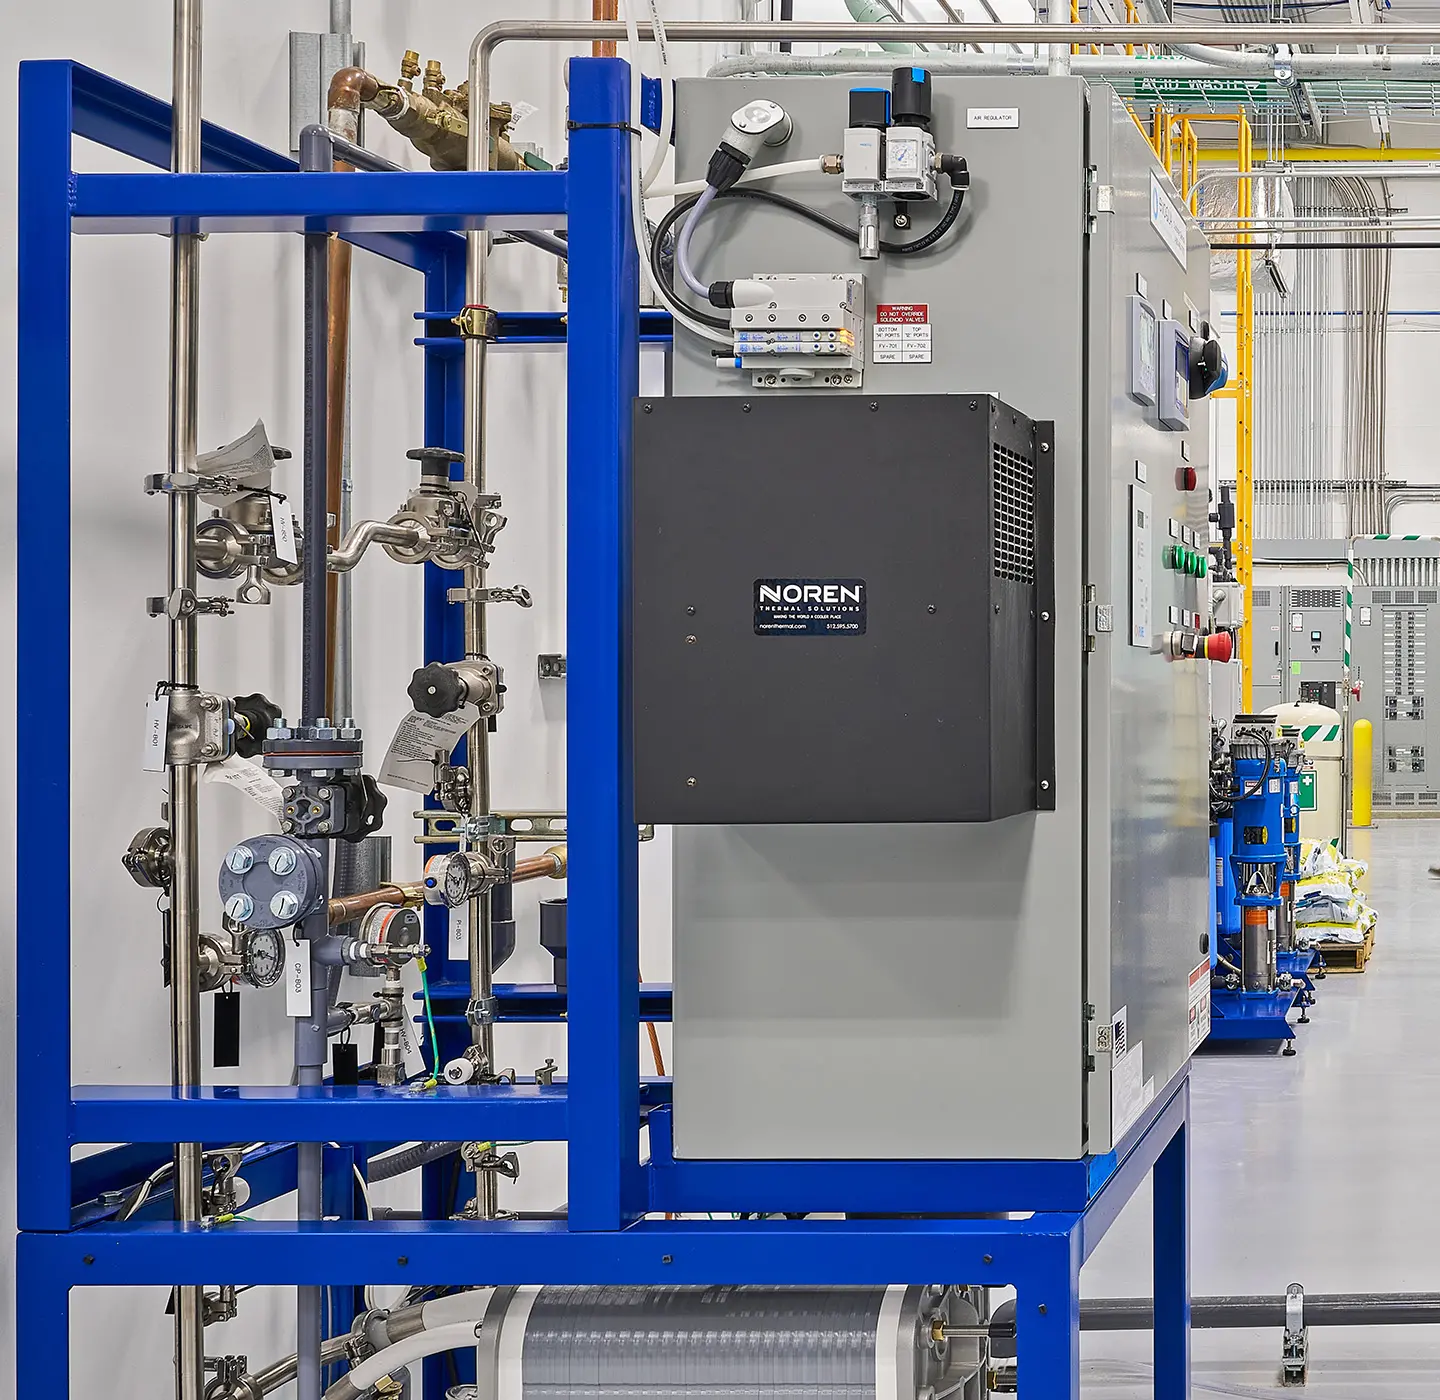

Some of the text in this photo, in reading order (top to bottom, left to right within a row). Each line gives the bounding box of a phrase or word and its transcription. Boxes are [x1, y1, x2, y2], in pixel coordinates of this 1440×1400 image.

[1141, 77, 1179, 91] ACID
[759, 584, 860, 603] NOREN
[152, 719, 160, 748] HV-801
[294, 962, 302, 994] CP-803
[399, 1027, 412, 1056] HV-804
[1097, 1027, 1107, 1048] SCE
